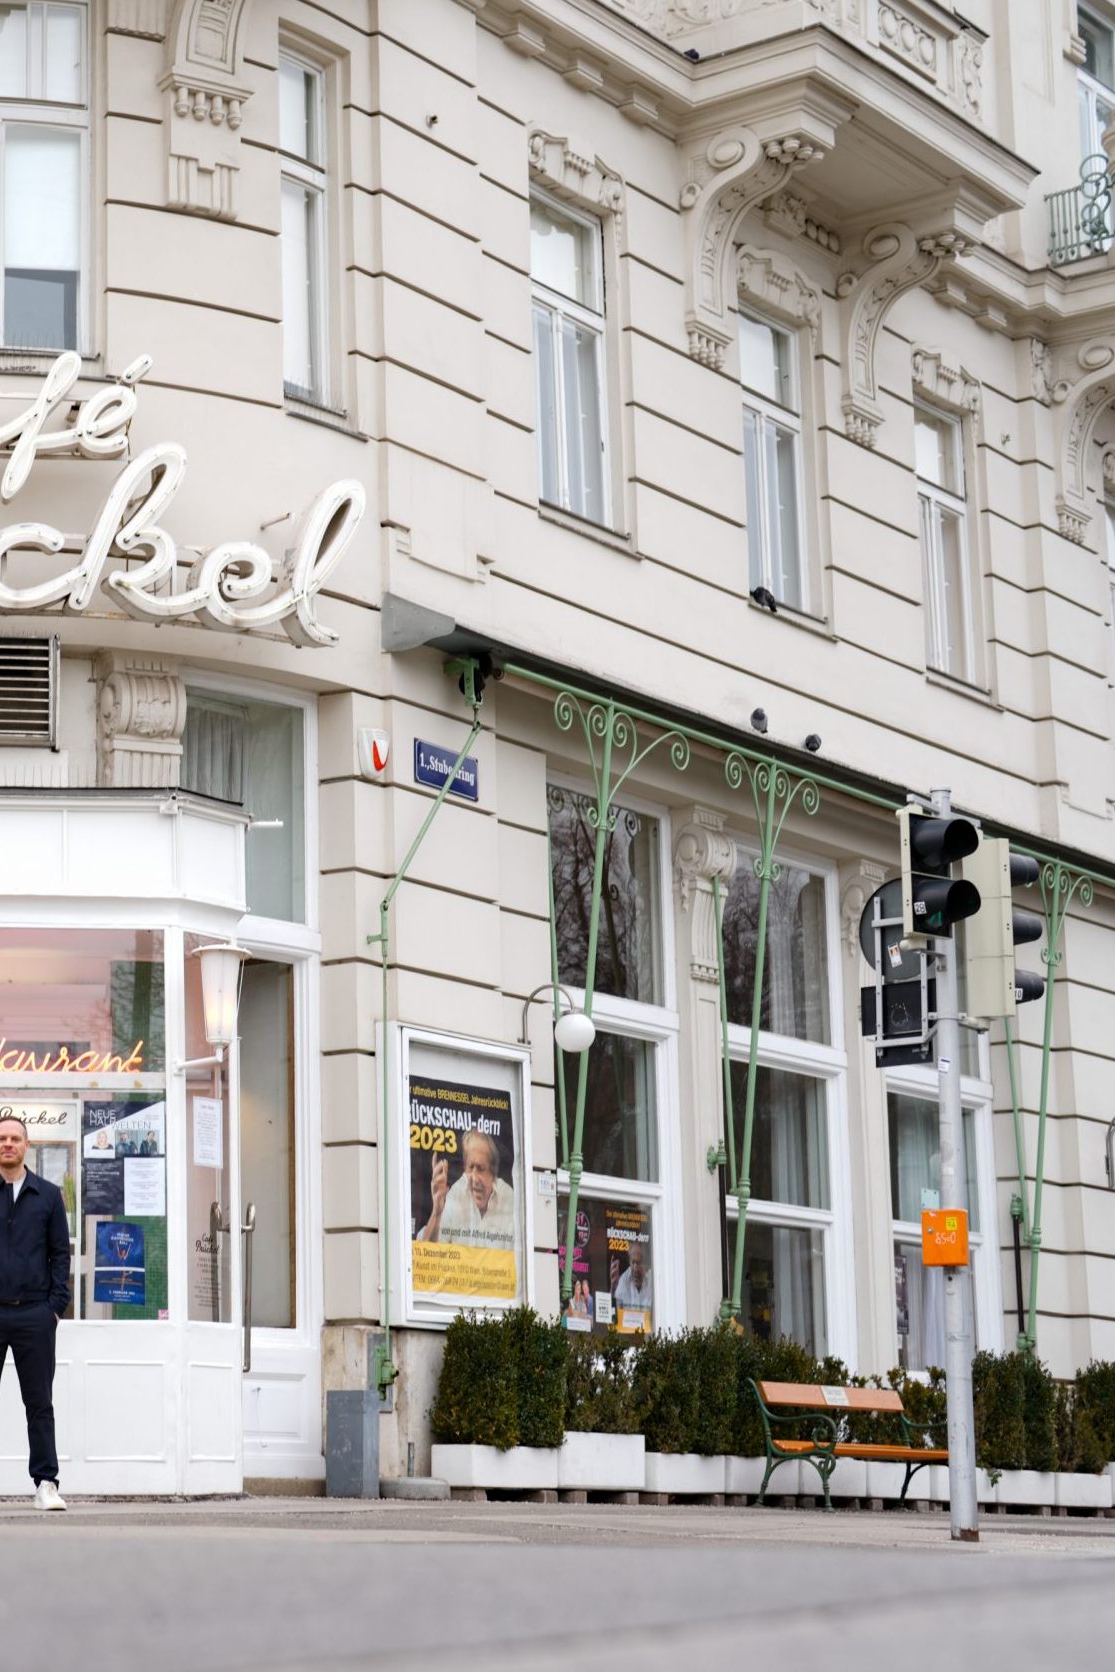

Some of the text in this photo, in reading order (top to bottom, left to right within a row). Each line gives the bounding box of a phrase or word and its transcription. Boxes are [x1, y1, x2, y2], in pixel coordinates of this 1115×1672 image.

[90, 1109, 116, 1119] NEUE
[410, 1124, 458, 1154] 2023
[608, 1238, 630, 1252] 2023
